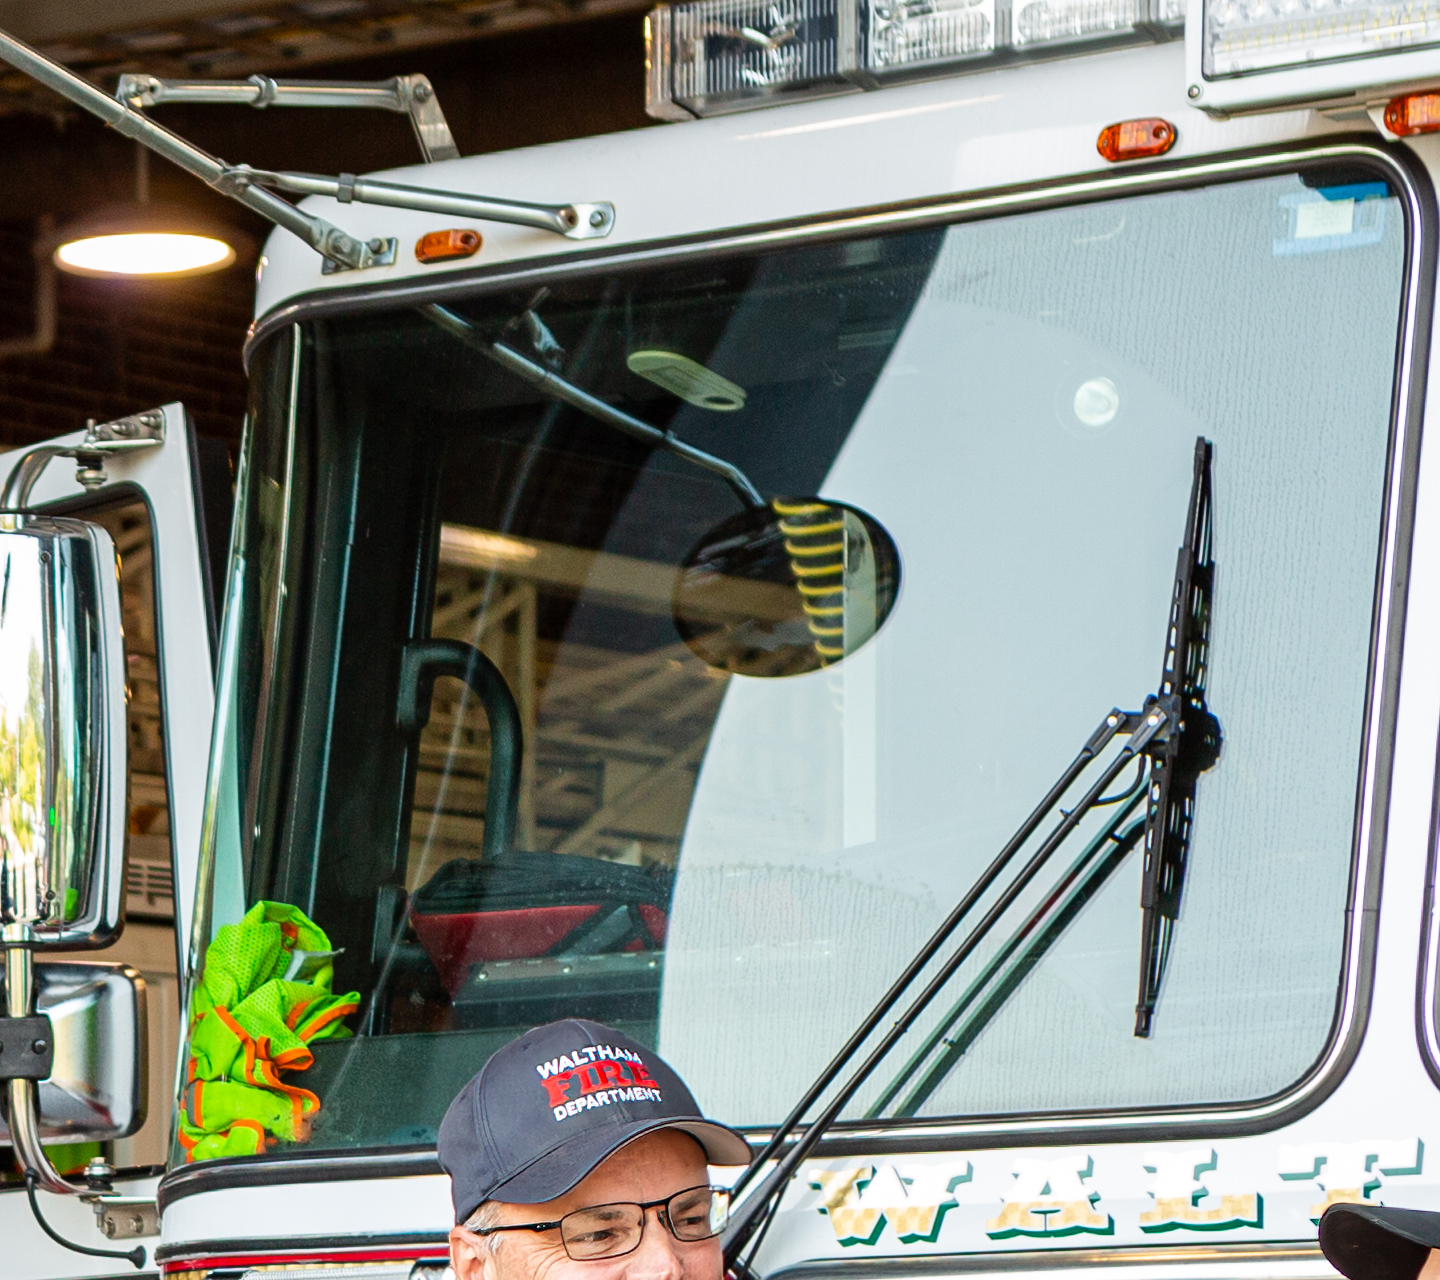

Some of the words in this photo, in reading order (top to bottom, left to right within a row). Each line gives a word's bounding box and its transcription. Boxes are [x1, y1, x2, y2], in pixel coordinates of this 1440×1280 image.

[536, 1045, 643, 1080] WALTHAM
[541, 1060, 660, 1108] FIRE
[553, 1087, 662, 1121] DEPARTMENT
